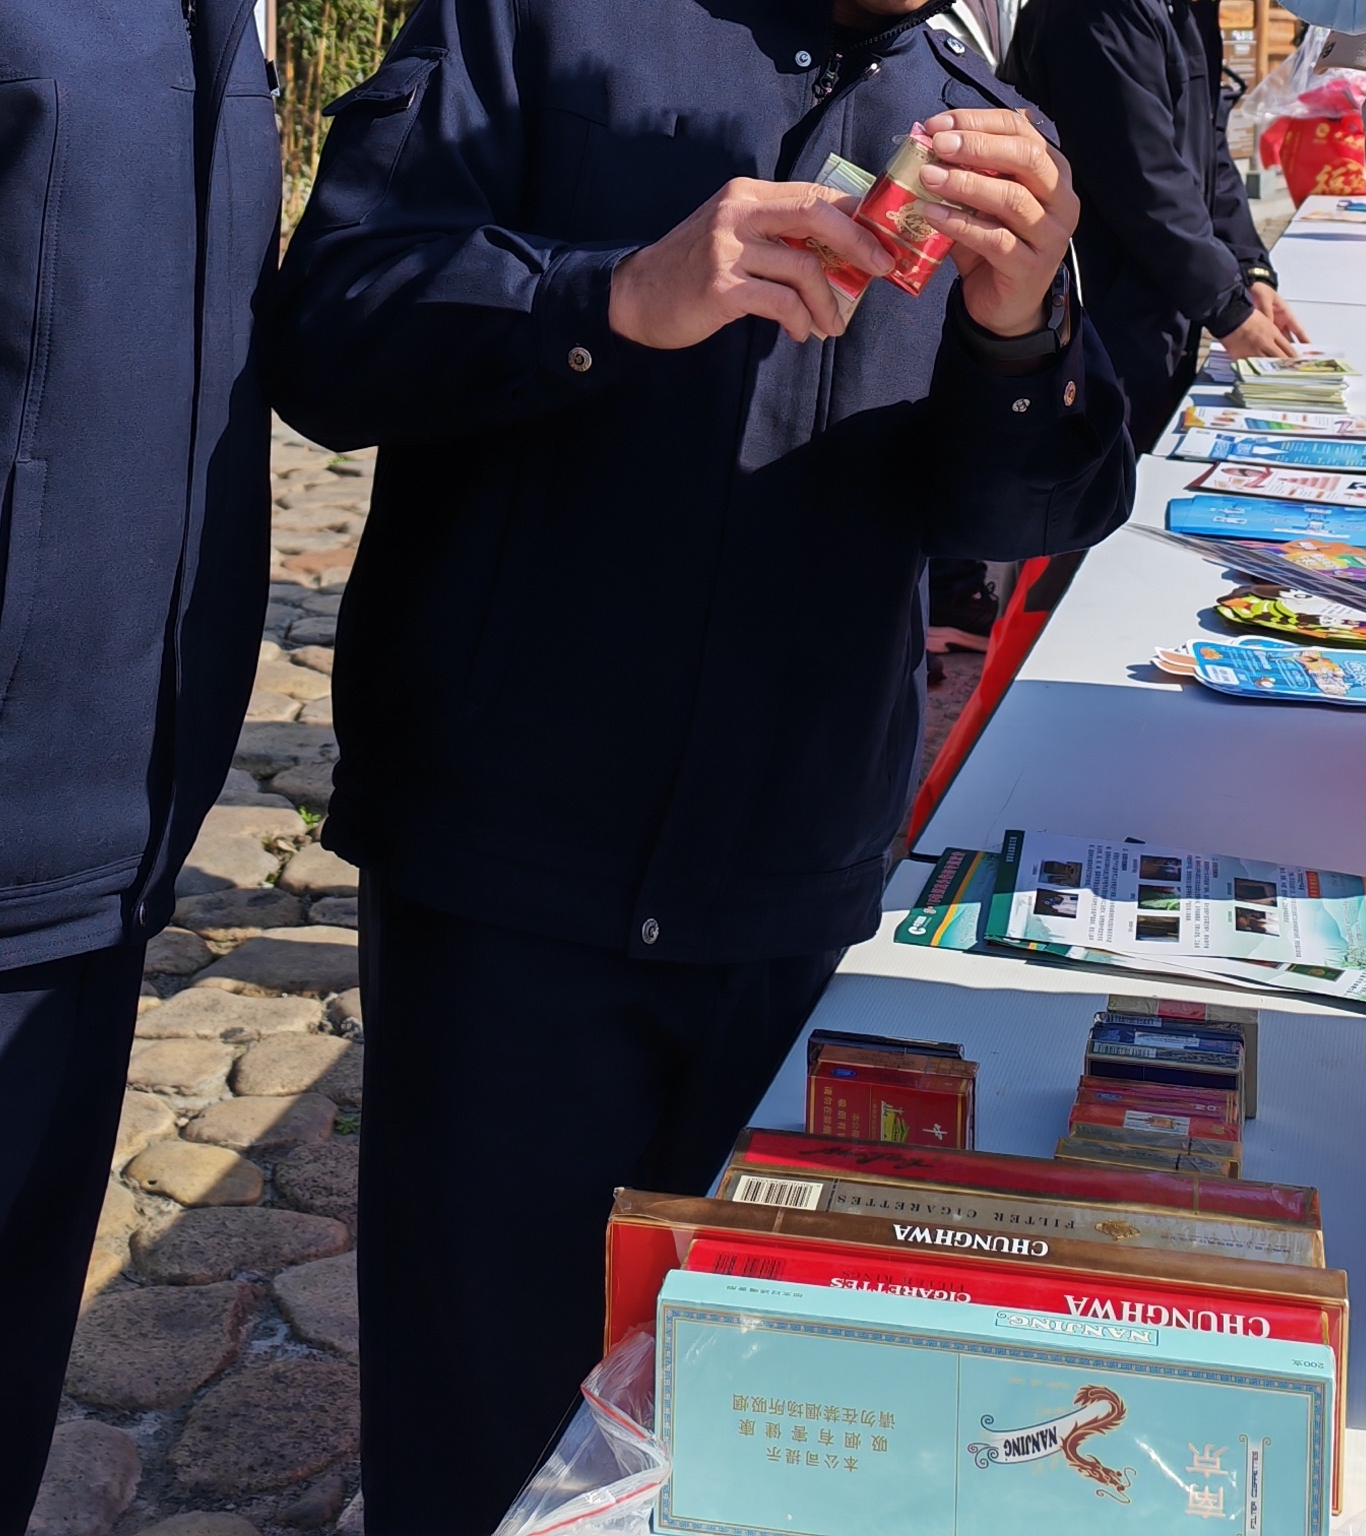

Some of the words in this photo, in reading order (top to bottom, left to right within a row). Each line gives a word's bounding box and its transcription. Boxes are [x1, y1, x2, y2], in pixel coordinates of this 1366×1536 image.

[835, 1193, 977, 1218] CIGARETTES
[991, 1210, 1075, 1229] FILTER
[891, 1222, 1049, 1257] CHUNGHWA
[828, 1276, 971, 1303] CIGARETTES
[1005, 1312, 1151, 1343] NANJING
[1062, 1293, 1270, 1339] CHUNGHWA
[730, 1392, 896, 1430] 请勿在禁烟场所吸烟
[736, 1417, 888, 1453] 吸烟有害健康
[1001, 1424, 1058, 1457] NANJING
[764, 1445, 859, 1472] 本公司提示
[1184, 1440, 1229, 1519] 南京
